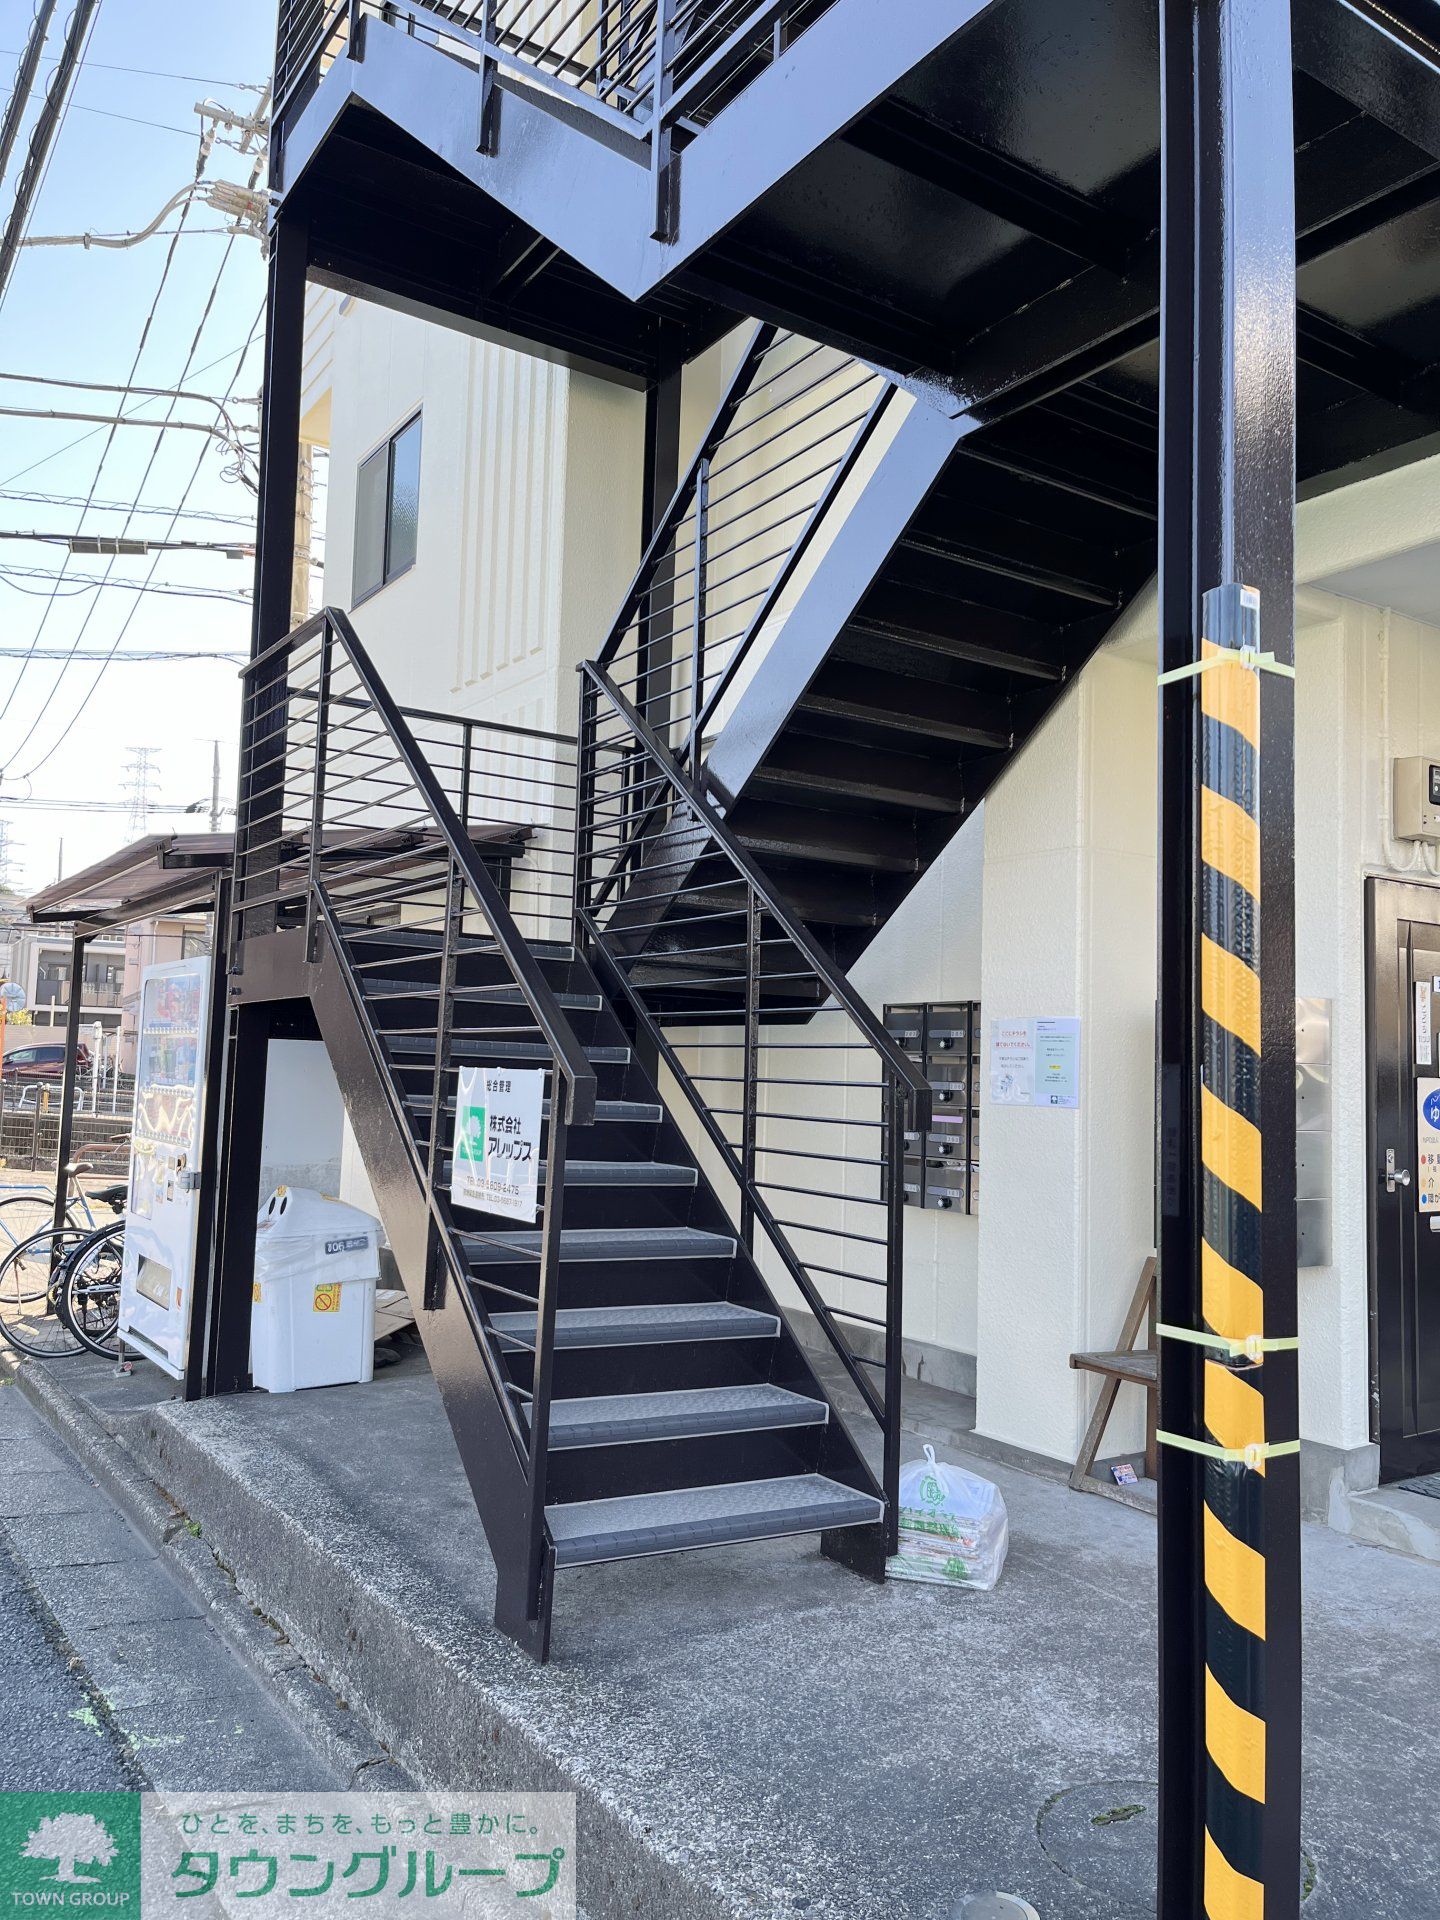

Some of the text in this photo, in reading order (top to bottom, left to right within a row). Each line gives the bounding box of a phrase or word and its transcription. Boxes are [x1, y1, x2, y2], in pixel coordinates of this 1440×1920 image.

[486, 1080, 512, 1093] 総合管理
[489, 1115, 522, 1135] 株式会社
